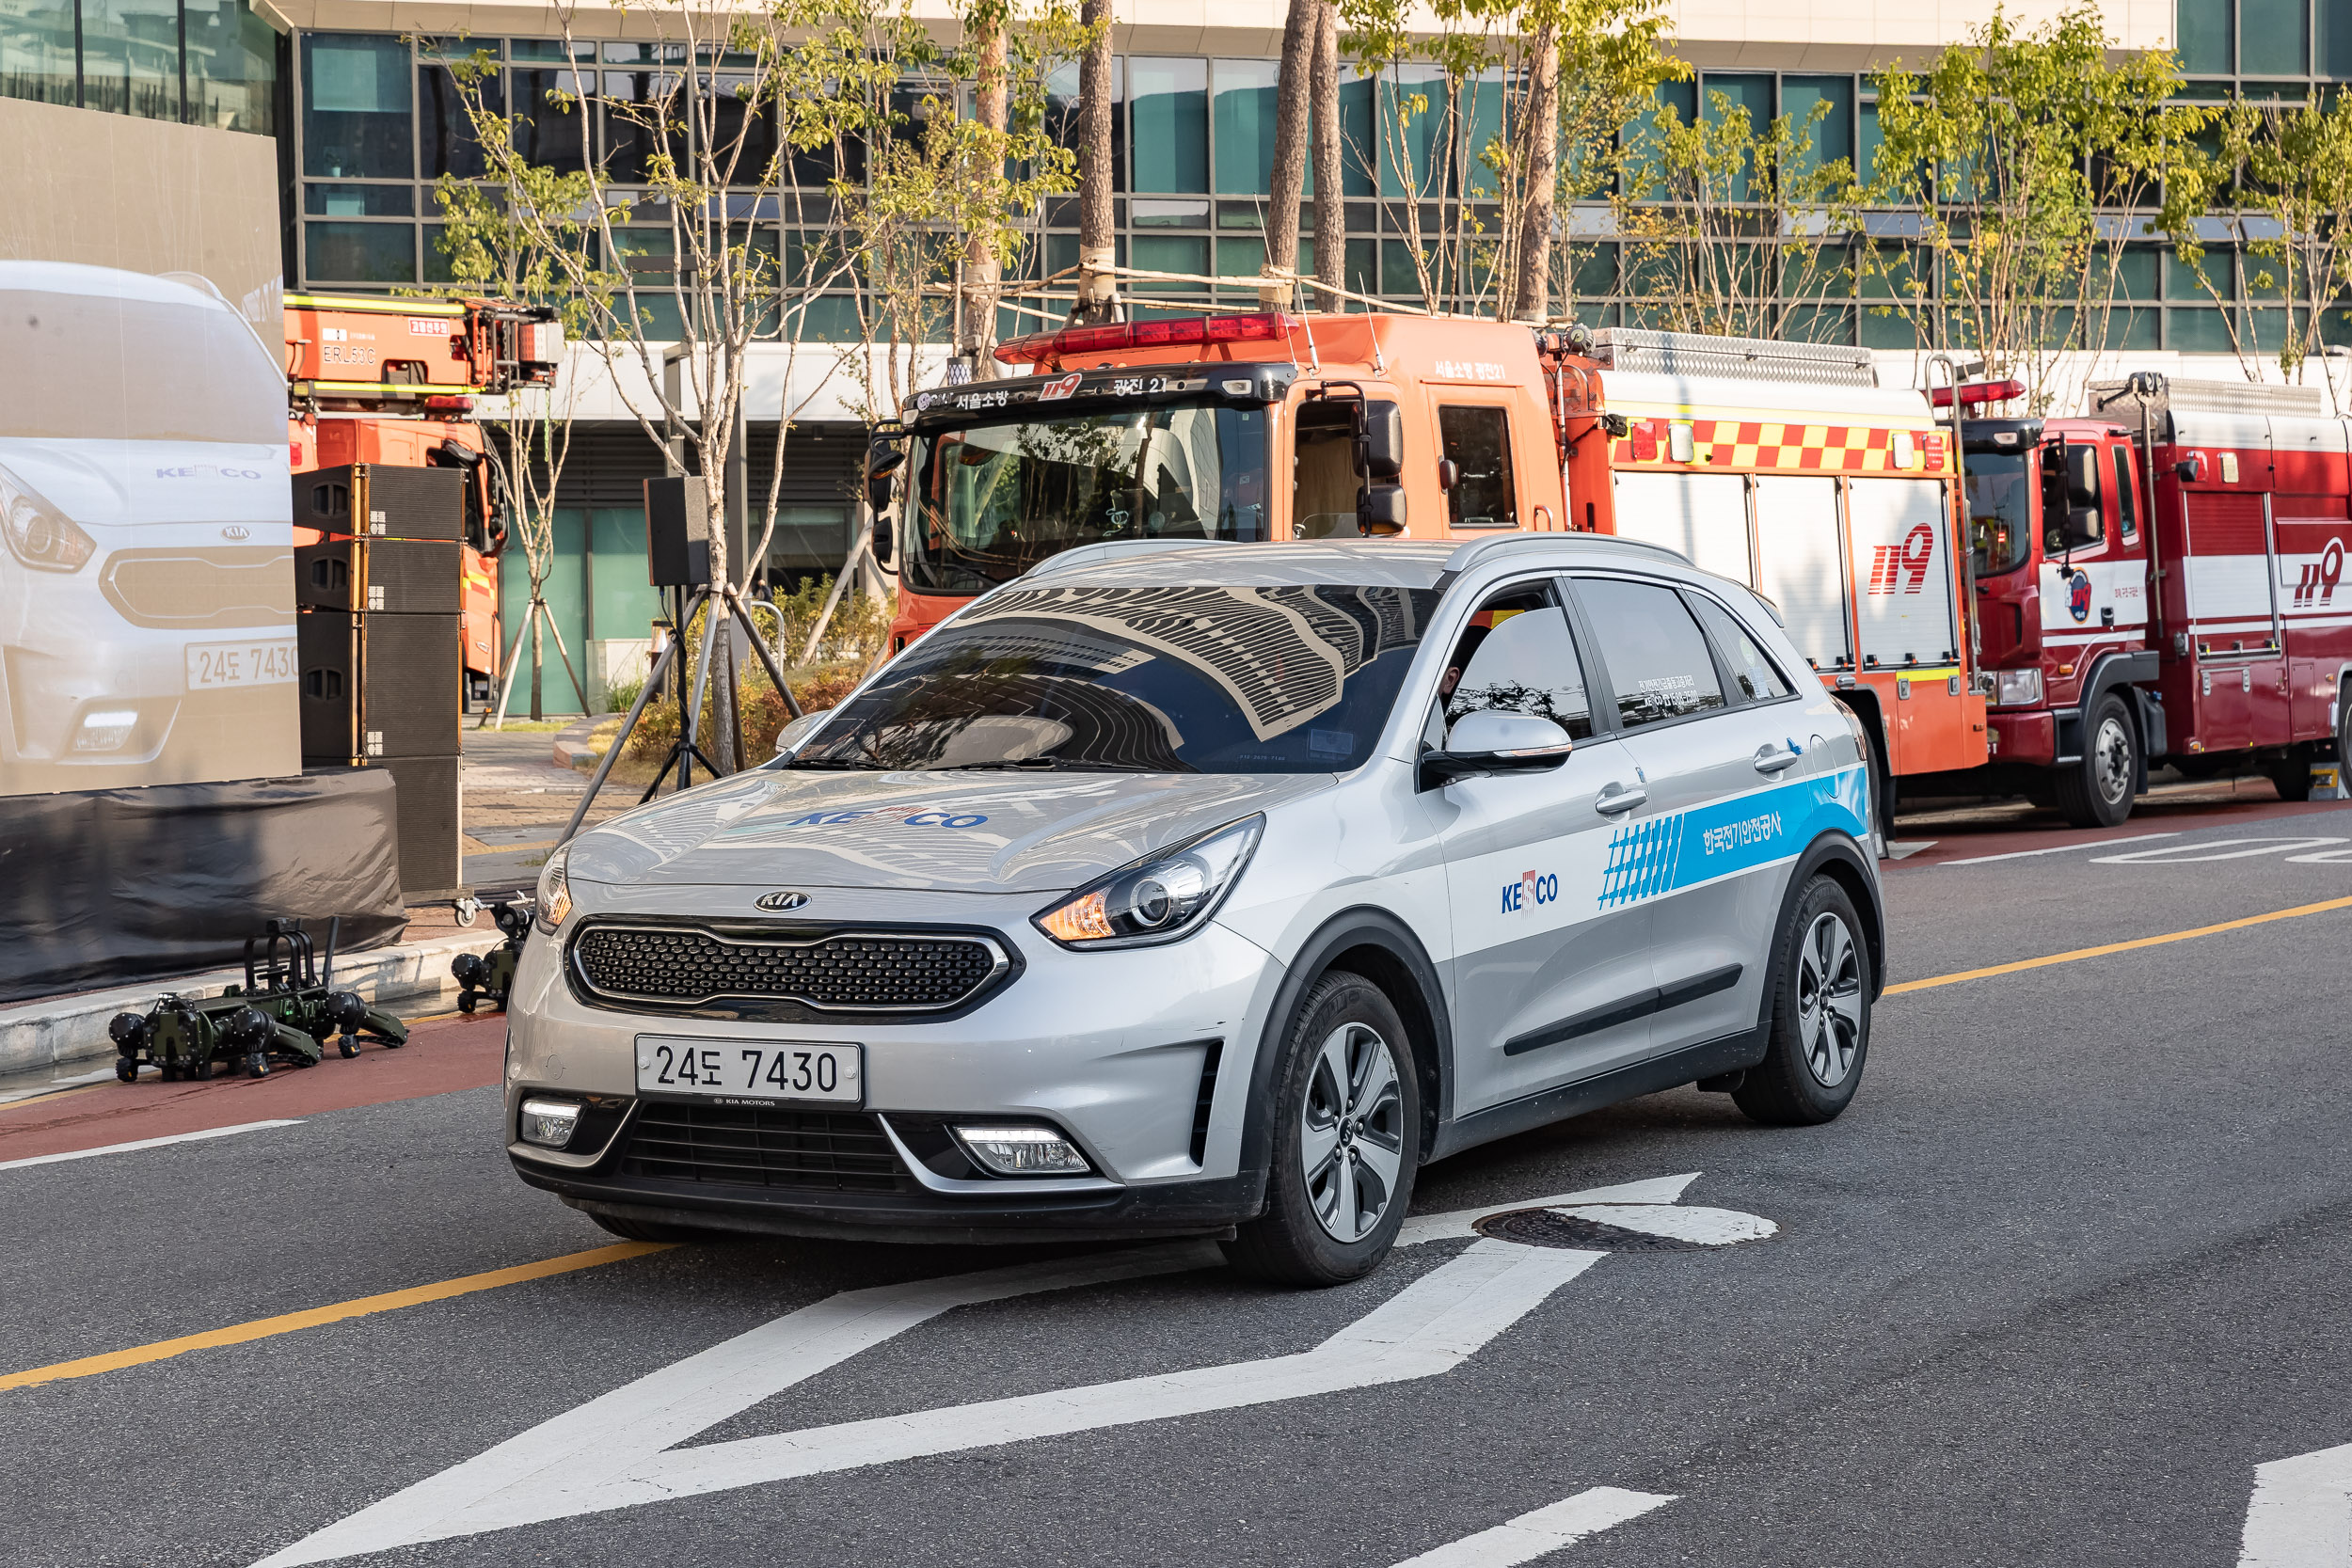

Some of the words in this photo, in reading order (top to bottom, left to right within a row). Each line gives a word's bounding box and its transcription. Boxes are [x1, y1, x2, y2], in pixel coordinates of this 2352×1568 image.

[324, 345, 375, 364] ERL53C
[1435, 360, 1472, 380] 서울소방
[1038, 373, 1082, 402] 119
[1113, 378, 1143, 396] 광진
[1149, 377, 1168, 393] 21
[956, 391, 1009, 410] 서울소방
[225, 527, 247, 537] KIA
[1867, 522, 1933, 594] 119
[2293, 542, 2343, 608] 119
[2072, 582, 2091, 610] 119
[199, 651, 240, 683] 24도
[1703, 811, 1783, 856] 한국전기안전공사
[760, 893, 800, 907] KIA
[656, 1045, 723, 1085] 24도
[742, 1050, 837, 1092] 7430
[1343, 1120, 1353, 1143] KIA
